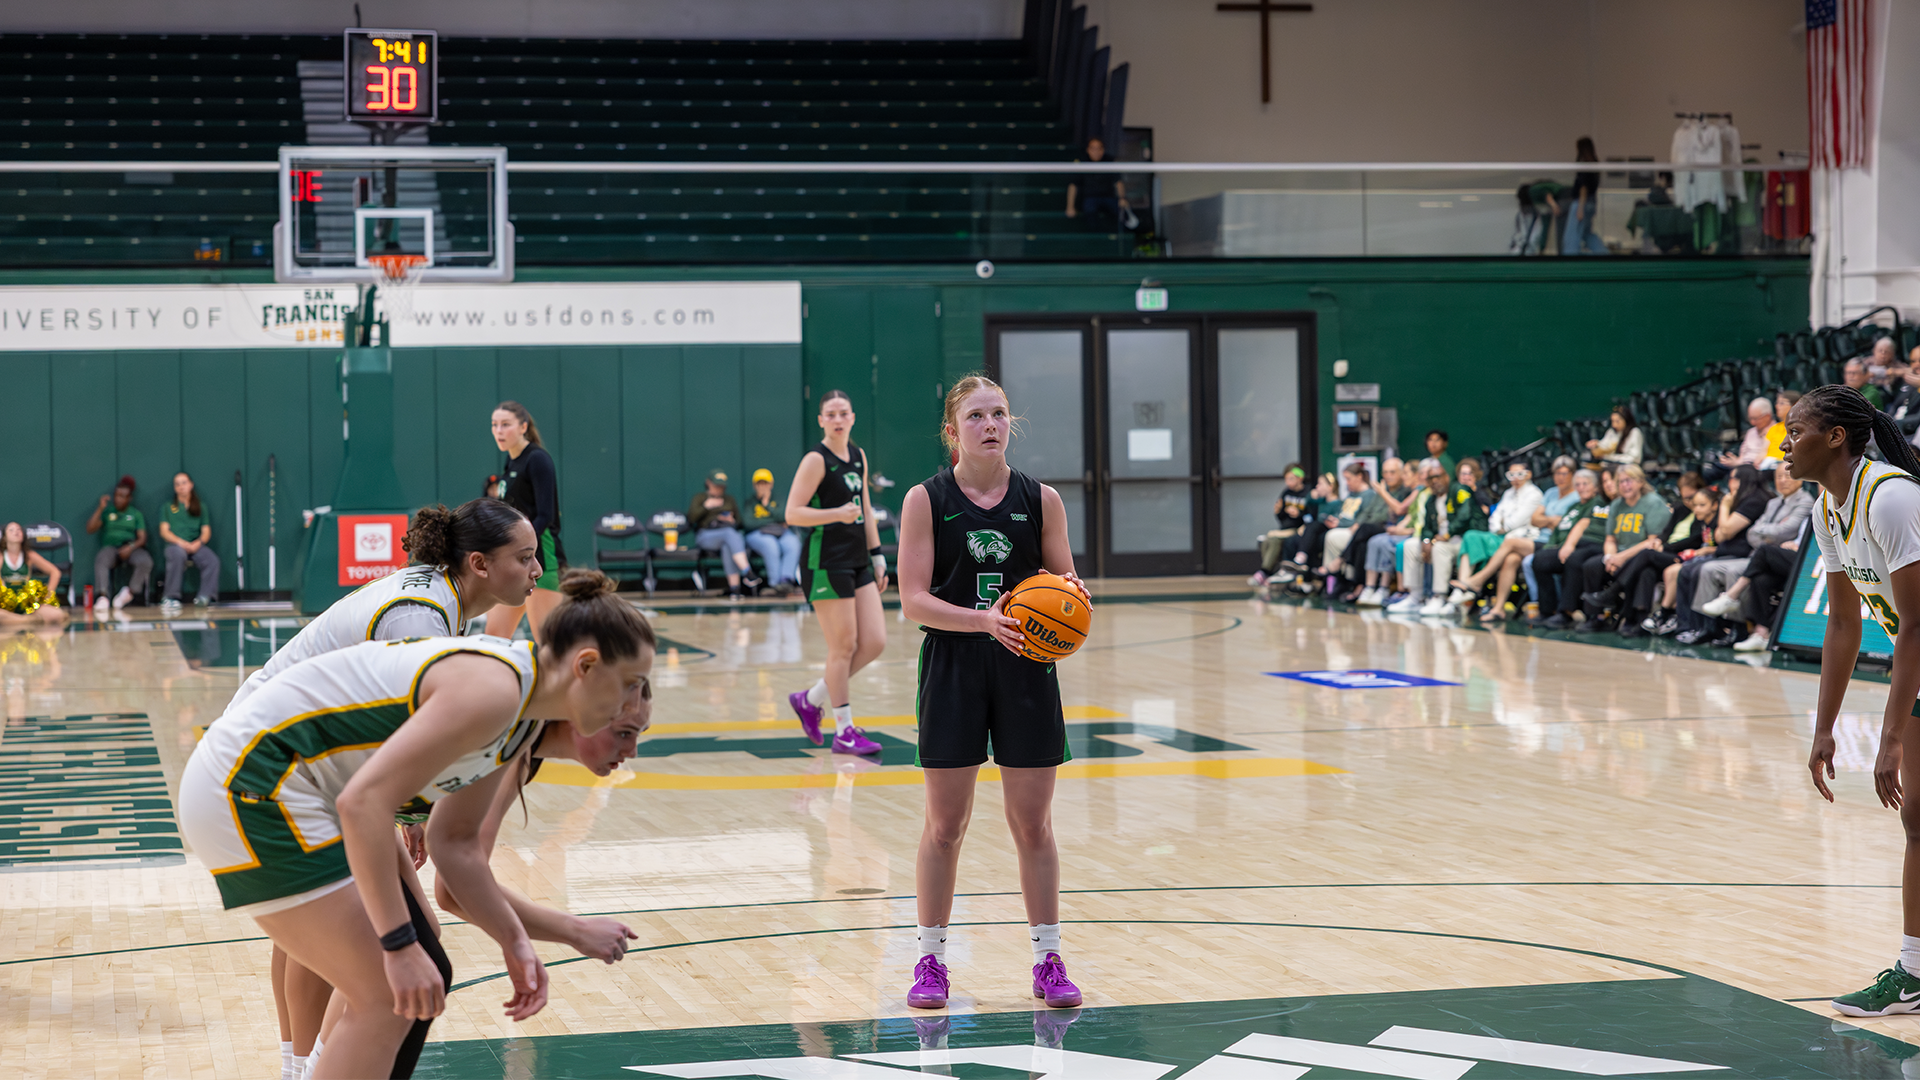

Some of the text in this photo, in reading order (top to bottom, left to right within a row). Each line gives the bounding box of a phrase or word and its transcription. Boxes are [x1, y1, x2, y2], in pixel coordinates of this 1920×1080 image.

[372, 38, 427, 64] 7:41
[365, 65, 418, 111] 30
[304, 289, 334, 300] SAN
[182, 306, 222, 329] OF
[414, 304, 715, 327] www.usfdons.com
[975, 572, 1003, 610] 5
[1025, 615, 1076, 651] Wilson
